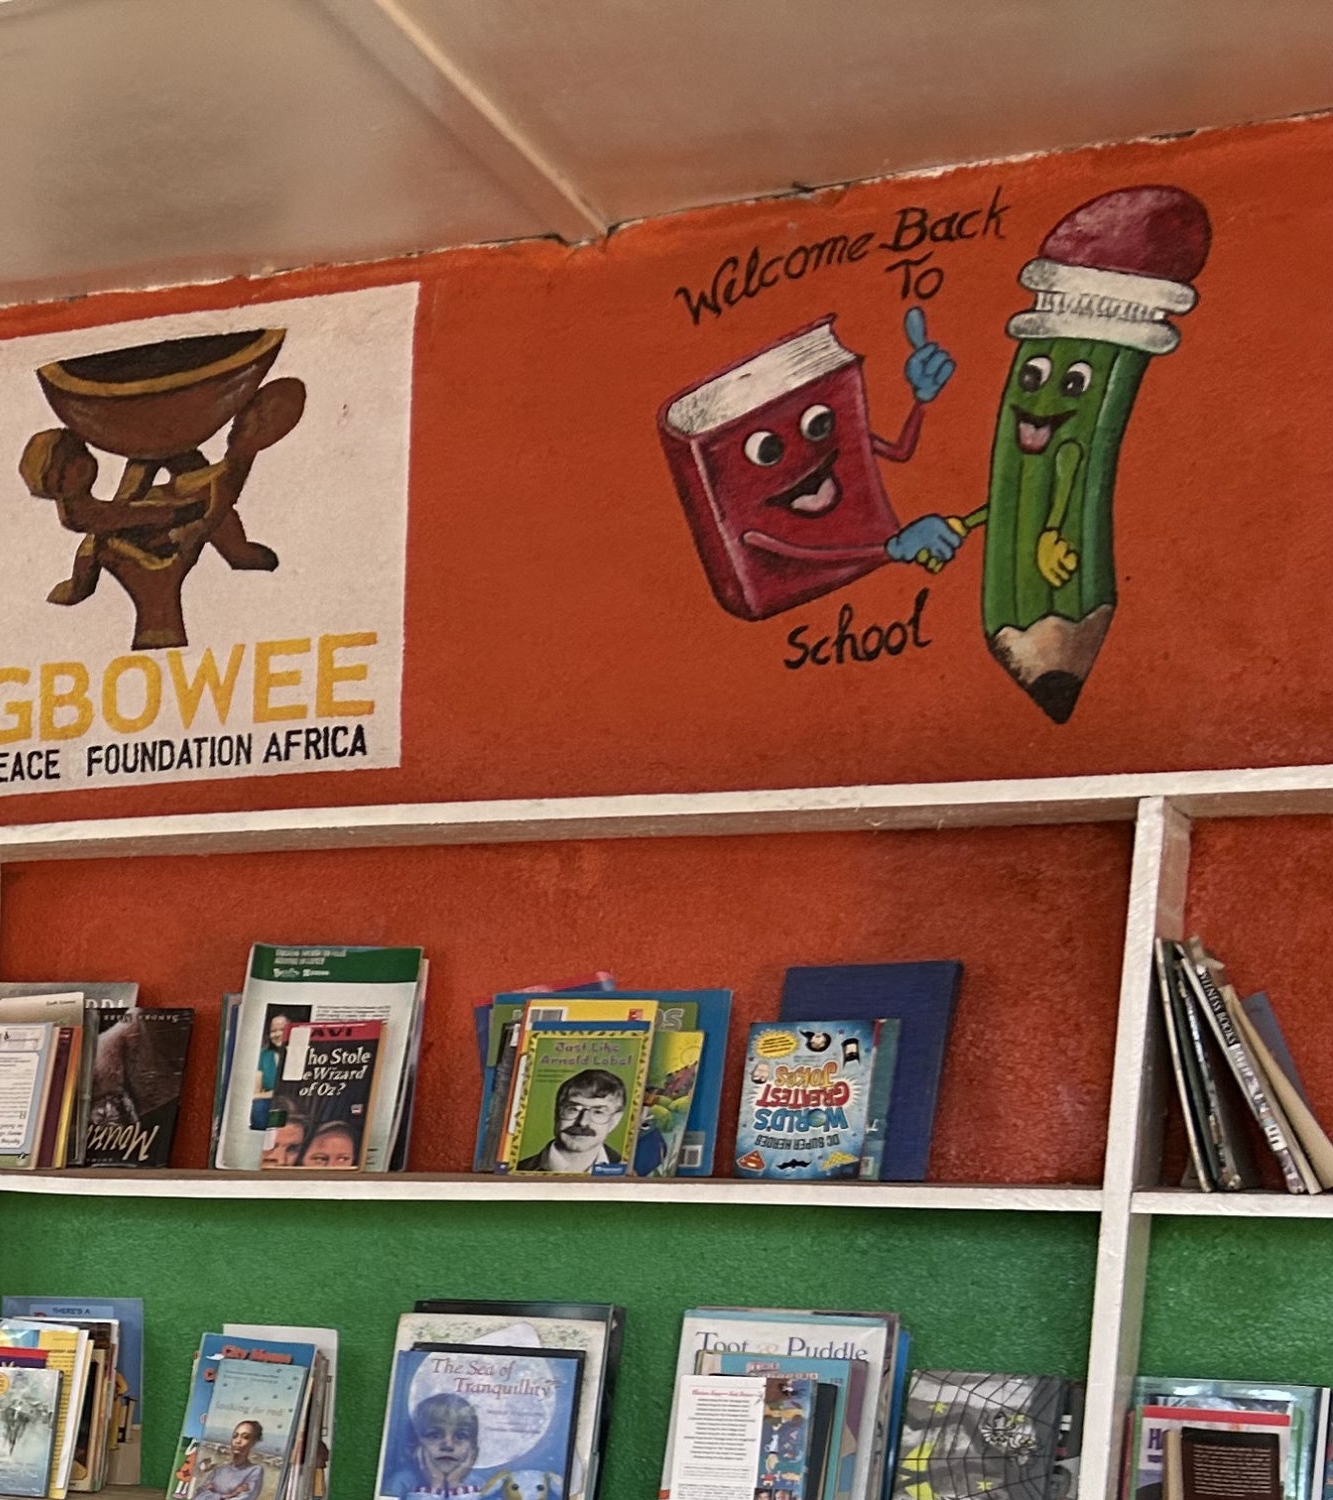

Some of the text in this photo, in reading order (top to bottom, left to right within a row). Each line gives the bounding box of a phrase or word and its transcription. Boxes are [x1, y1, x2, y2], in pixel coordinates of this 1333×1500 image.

[675, 187, 1010, 325] Welcome Back
[884, 215, 945, 301] To
[784, 588, 931, 669] School
[86, 732, 252, 777] FOUNDATION
[262, 724, 367, 764] AFRICA
[310, 1028, 353, 1038] AVI
[1217, 1009, 1241, 1047] BOOKS
[306, 1047, 372, 1066] ho Stole
[555, 1040, 620, 1053] Just Like
[314, 1066, 367, 1081] Wizard
[540, 1055, 633, 1066] Arnold Lobel
[775, 1061, 839, 1088] JOKES
[299, 1083, 347, 1097] of Oz?
[756, 1081, 851, 1110] GREATEST
[753, 1107, 849, 1133] WORLD'S
[754, 1133, 841, 1151] DC SUPER HEROES
[696, 1331, 868, 1361] Toot Puddle
[432, 1357, 516, 1382] The Sea of
